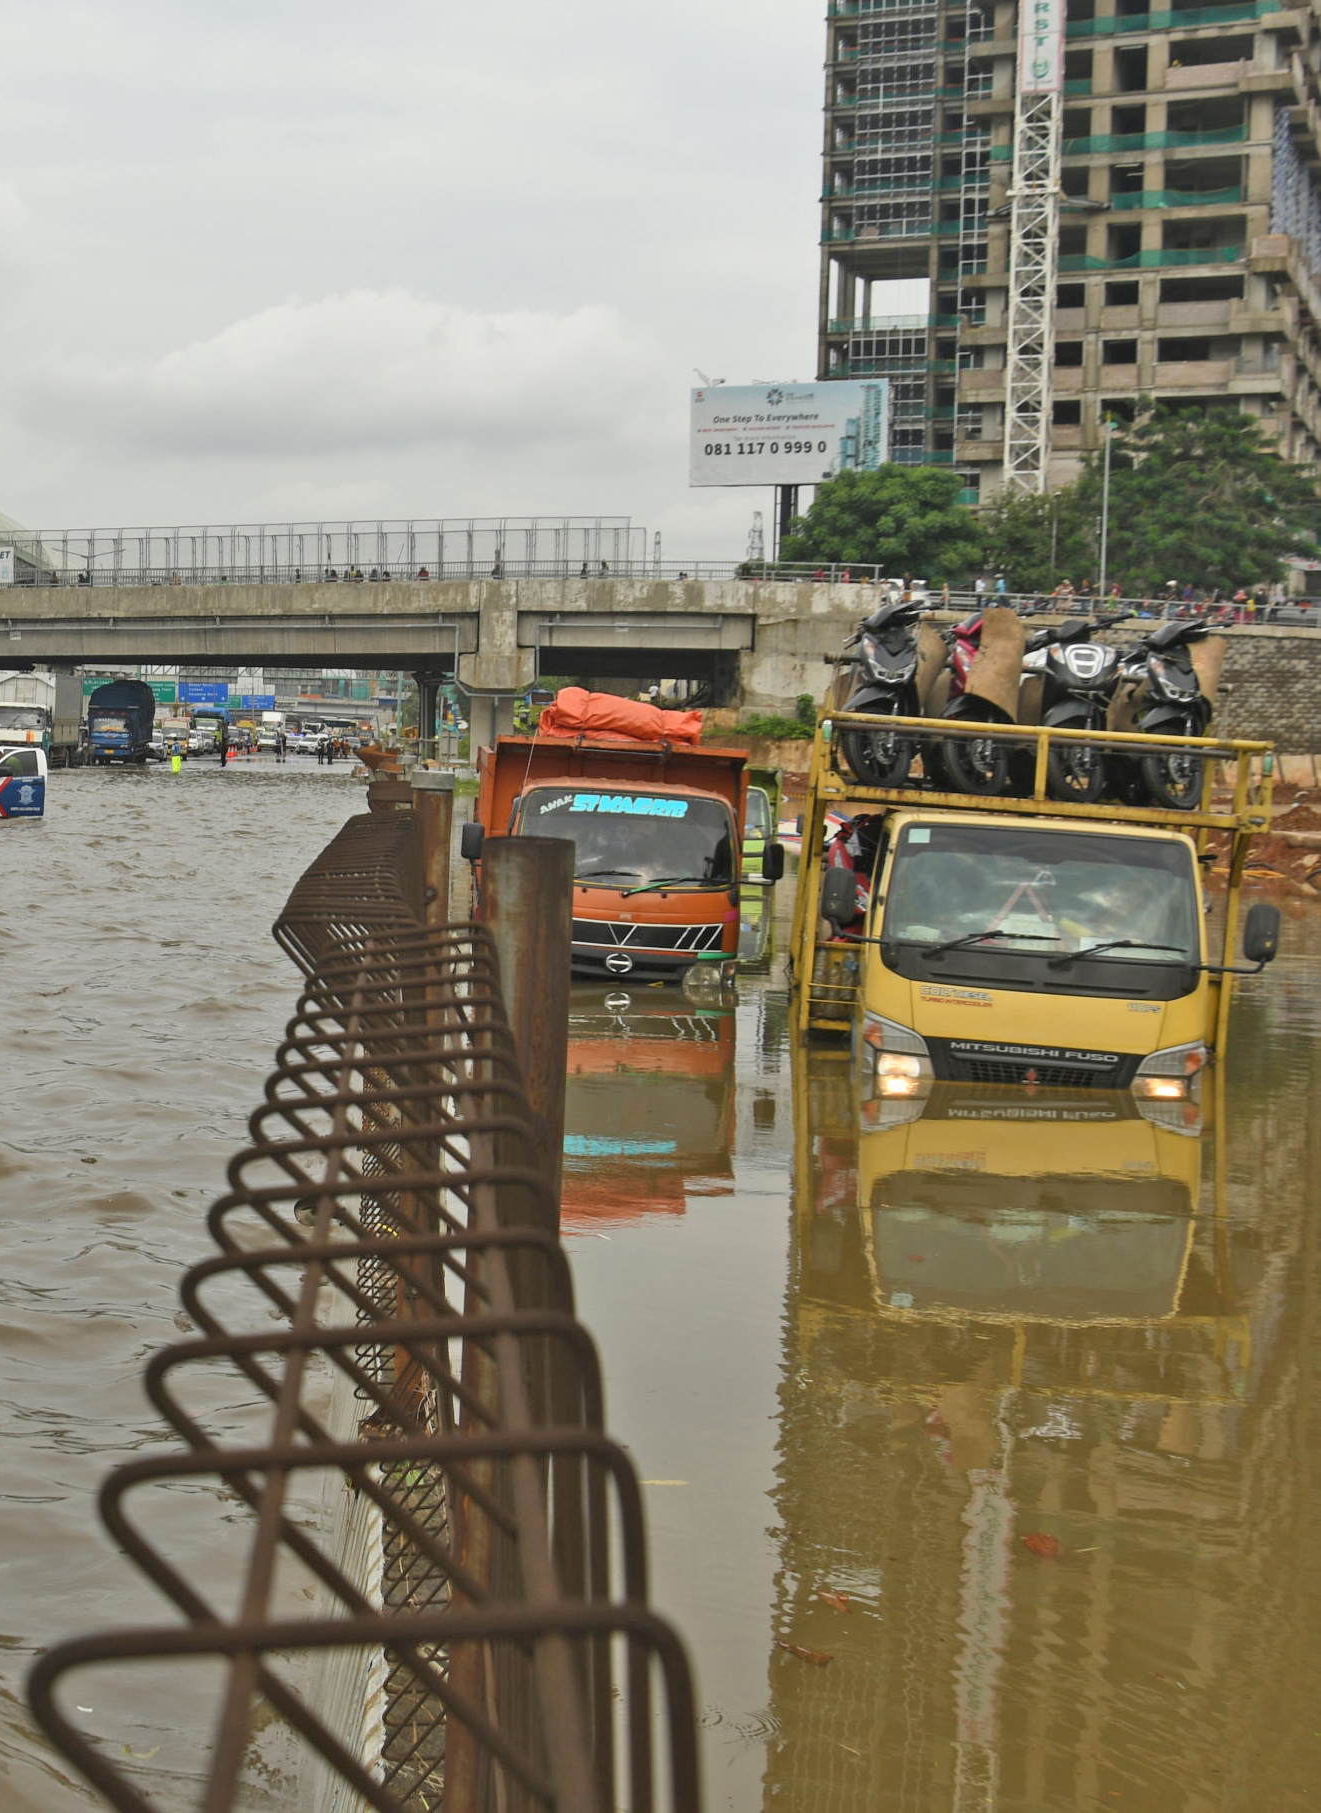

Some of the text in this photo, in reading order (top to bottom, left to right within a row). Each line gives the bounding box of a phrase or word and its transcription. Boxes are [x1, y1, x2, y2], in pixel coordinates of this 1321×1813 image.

[713, 413, 819, 424] One Step To Everywhere
[704, 440, 827, 456] 081 117 0 999 0
[540, 794, 573, 814] ANAK
[920, 986, 955, 997] COLT
[950, 1042, 1119, 1063] MITSUBISHI FUSO
